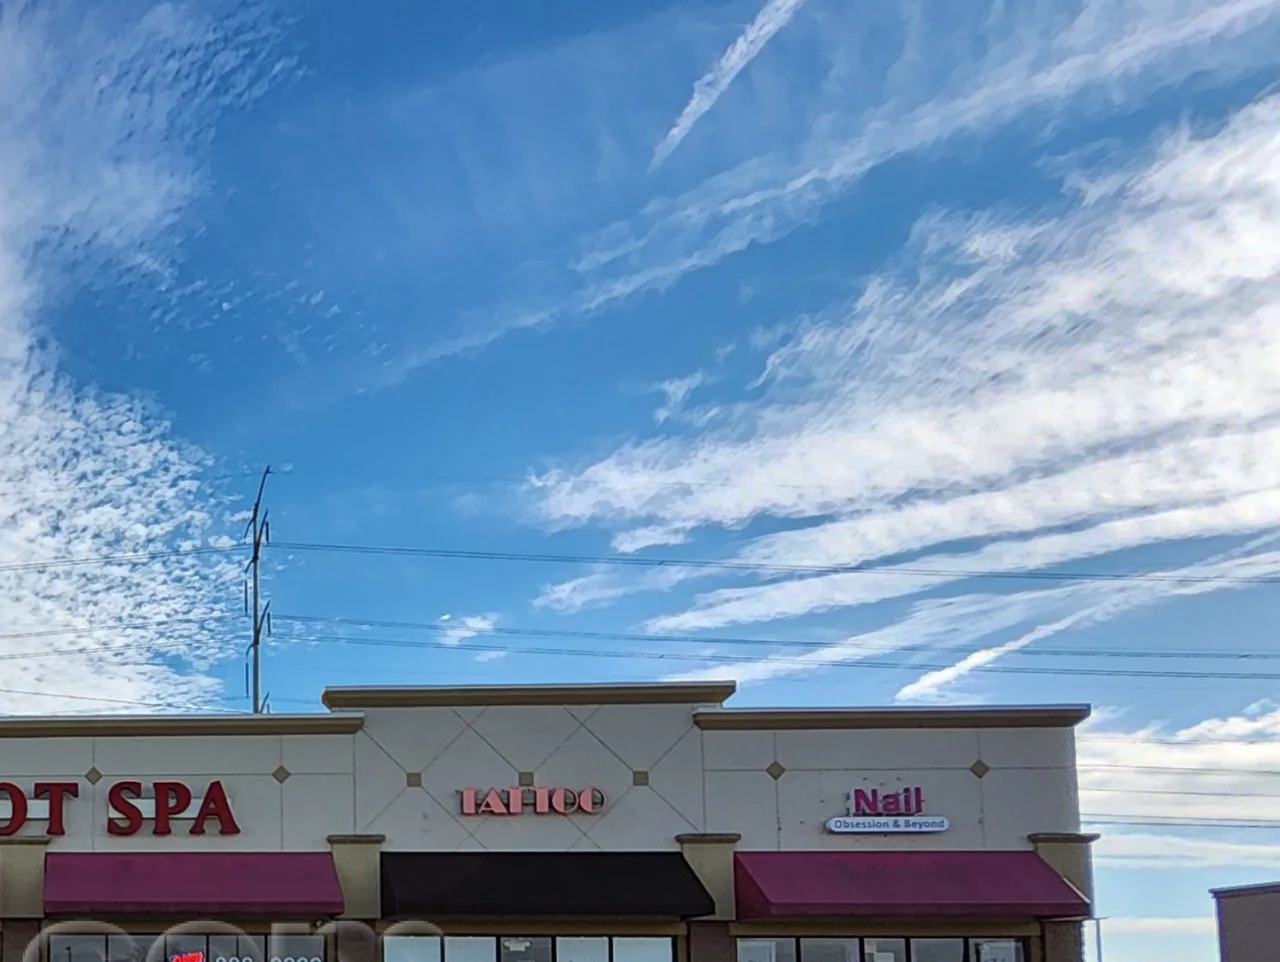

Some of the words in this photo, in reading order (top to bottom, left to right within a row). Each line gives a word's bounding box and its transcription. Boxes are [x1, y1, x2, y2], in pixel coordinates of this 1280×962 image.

[107, 780, 241, 837] SPA
[454, 787, 606, 815] TATTOO
[854, 787, 923, 813] Nail
[834, 819, 889, 829] Obsession
[892, 819, 901, 828] &
[904, 819, 945, 830] Beyond
